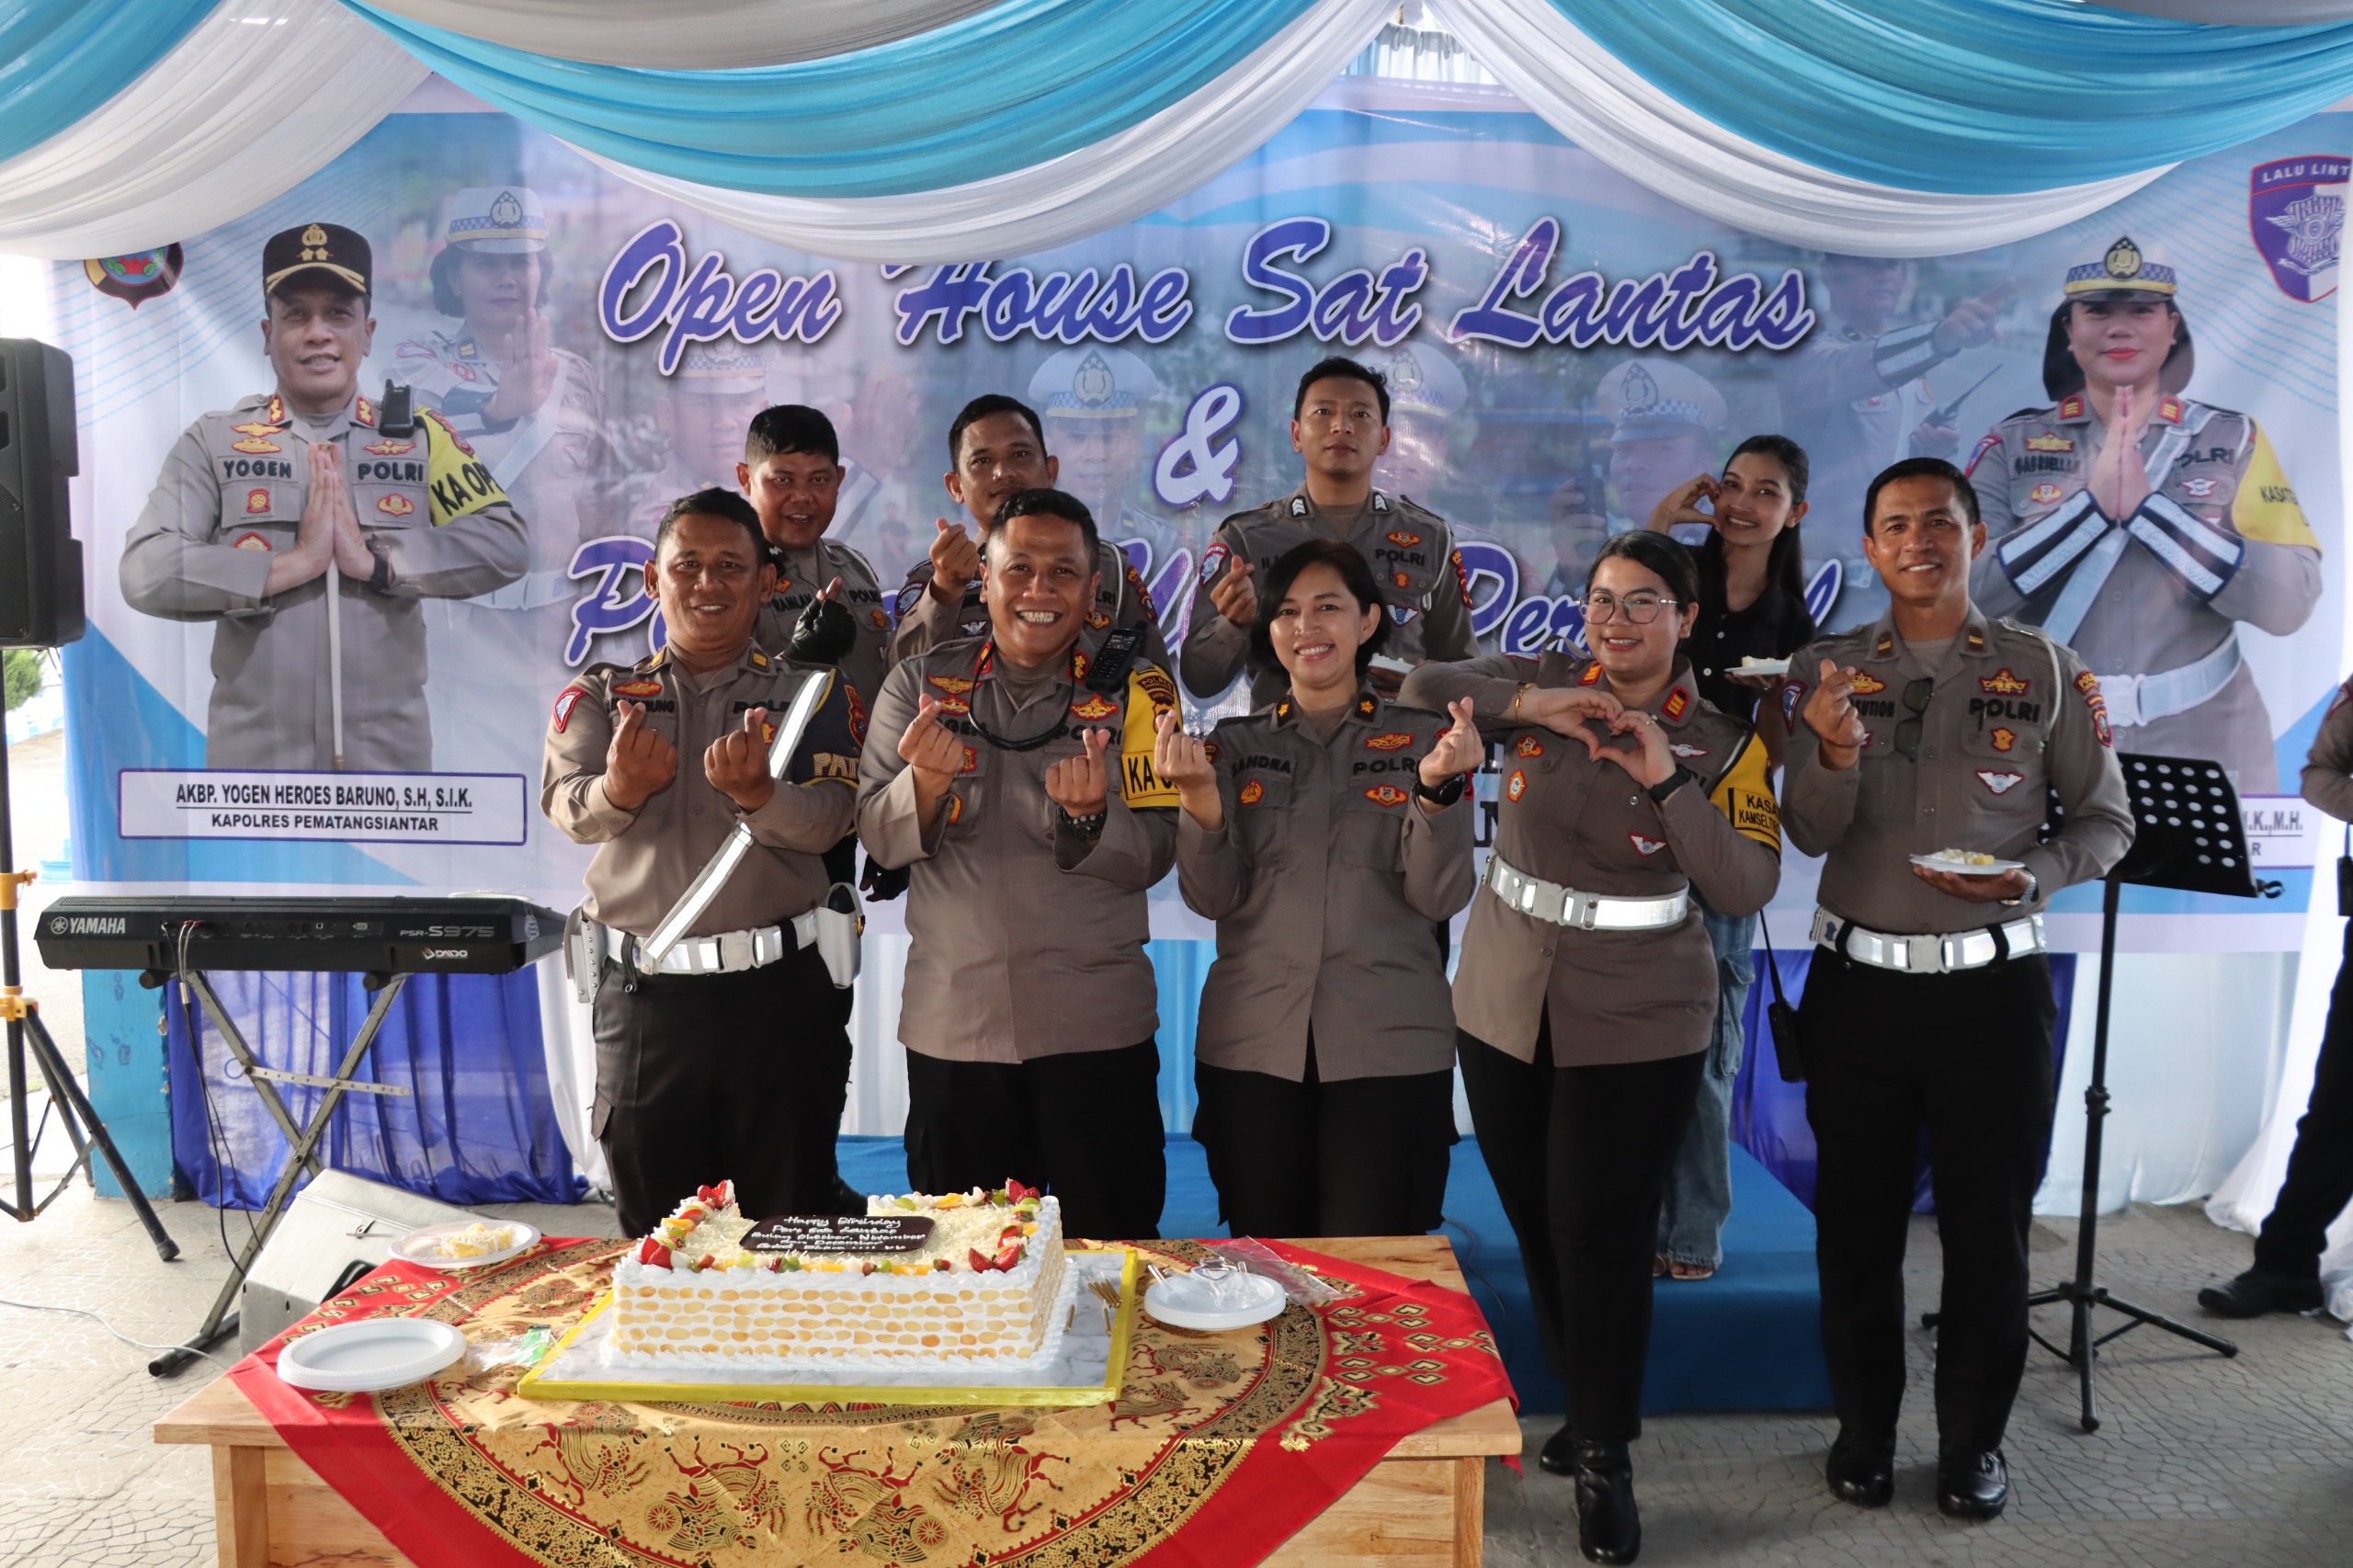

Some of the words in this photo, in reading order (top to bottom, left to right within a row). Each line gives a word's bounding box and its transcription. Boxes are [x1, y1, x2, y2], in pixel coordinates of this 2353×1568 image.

[2262, 165, 2305, 184] LALU
[599, 219, 842, 376] Open
[881, 260, 1193, 345] House
[1225, 217, 1428, 347] Sat
[1449, 217, 1817, 351] Lantas
[1152, 381, 1245, 508] &
[223, 460, 291, 479] YOGEN
[358, 461, 424, 483] POLRI
[430, 472, 473, 517] KA
[1374, 548, 1425, 567] POLRI
[1969, 697, 2040, 723] POLRI
[1128, 756, 1156, 794] KA
[176, 784, 218, 804] AKBP.
[222, 784, 271, 805] YOGEN
[276, 785, 332, 806] HEROES
[335, 786, 400, 811] BARUNO,
[404, 788, 432, 812] S.H,
[436, 788, 472, 808] S.I.K.
[211, 813, 290, 829] KAPOLRES
[293, 814, 439, 832] PEMATANGSIANTAR
[70, 917, 127, 935] YAMAHA
[400, 925, 495, 937] PSR-S975
[435, 949, 469, 960] DAIDO
[784, 1216, 829, 1228] Happy
[838, 1216, 901, 1229] Birthday
